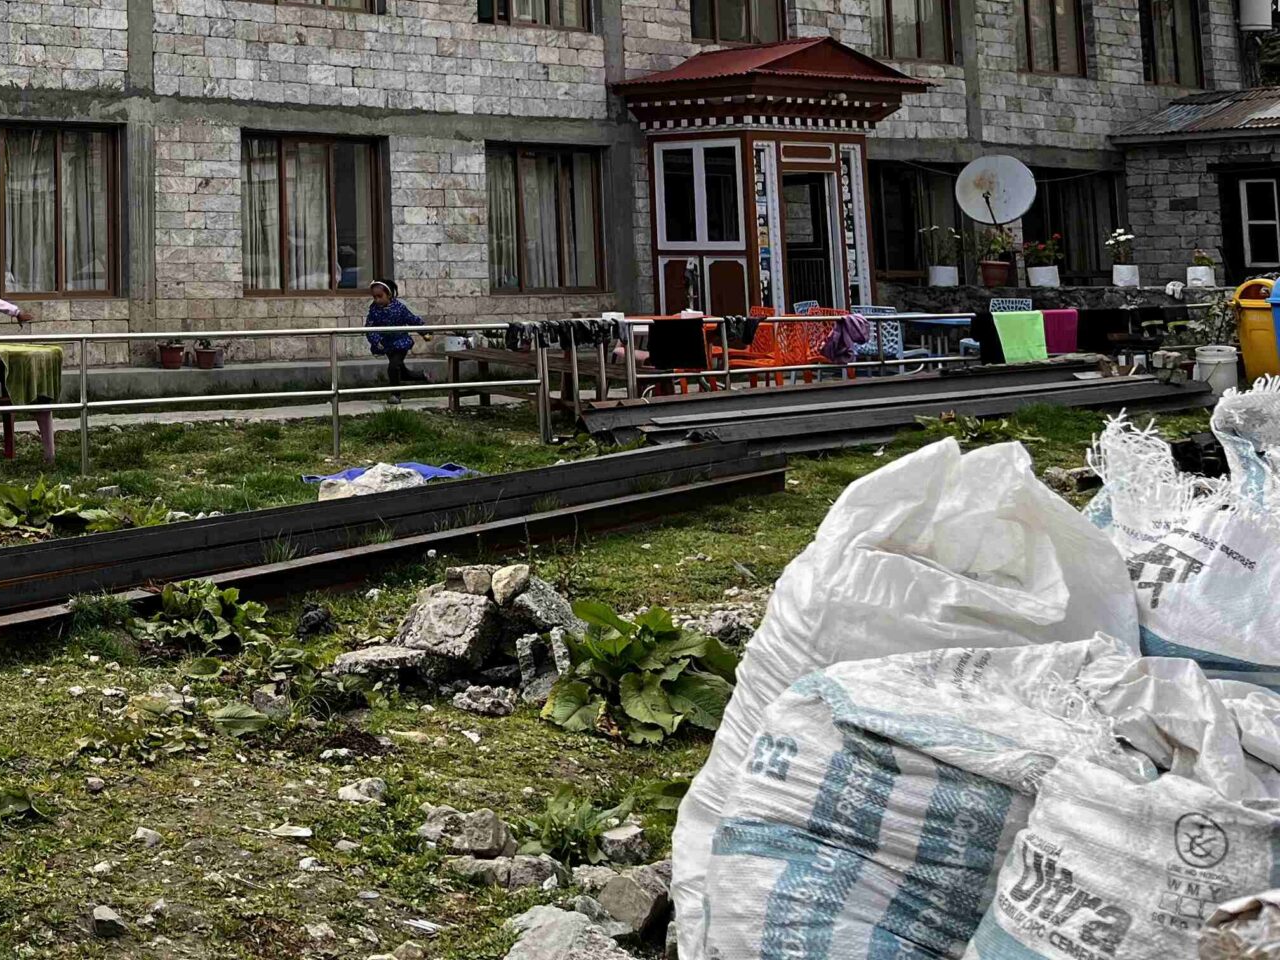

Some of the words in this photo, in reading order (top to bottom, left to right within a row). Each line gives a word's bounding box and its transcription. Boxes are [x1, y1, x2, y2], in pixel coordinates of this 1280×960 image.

[1167, 877, 1182, 891] W
[1185, 882, 1200, 896] M
[1208, 886, 1221, 900] Y
